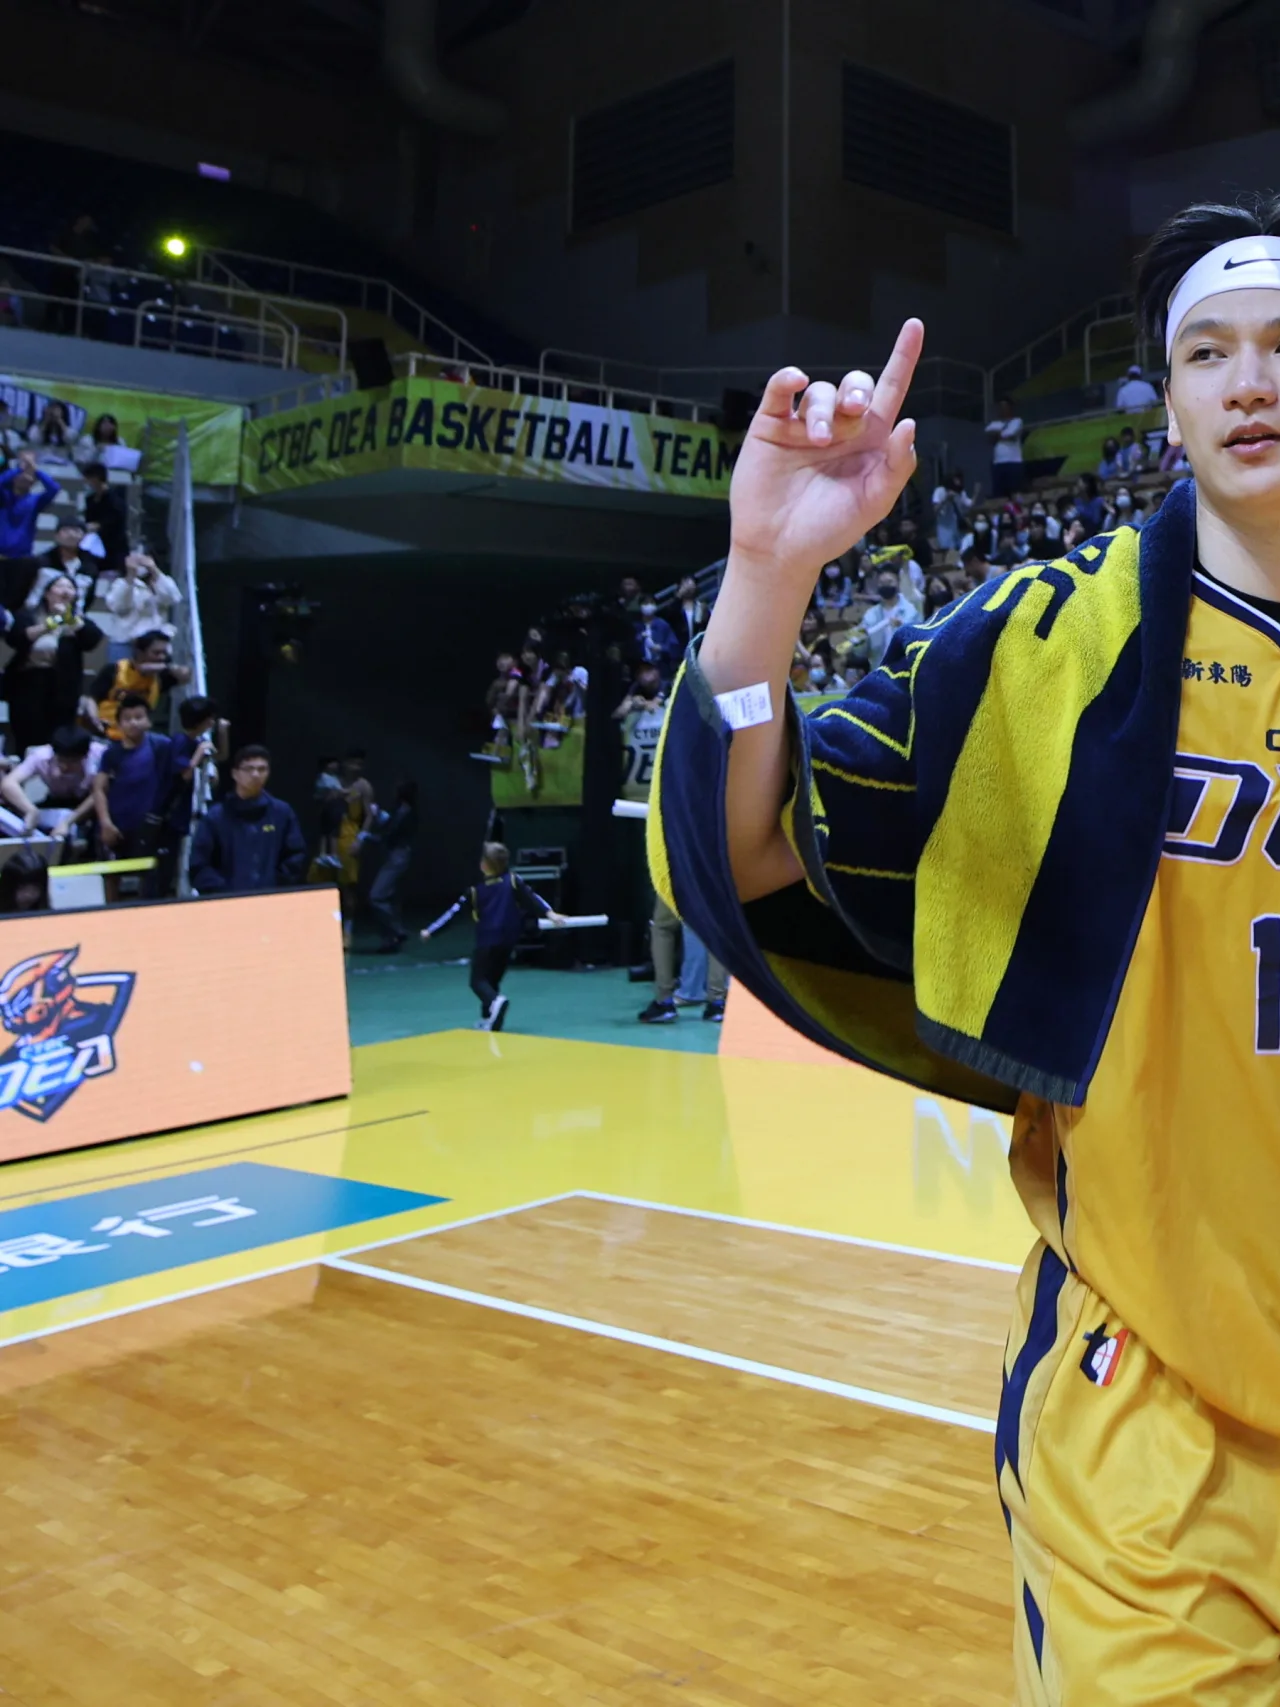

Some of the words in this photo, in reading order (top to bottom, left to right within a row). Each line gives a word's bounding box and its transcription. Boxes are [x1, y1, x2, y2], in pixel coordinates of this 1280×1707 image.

[258, 417, 323, 474] CTBC
[326, 404, 377, 460] DEA
[386, 397, 634, 470] BASKETBALL
[653, 430, 742, 480] TEAM
[1181, 656, 1253, 688] 新東陽
[634, 728, 662, 740] CTB
